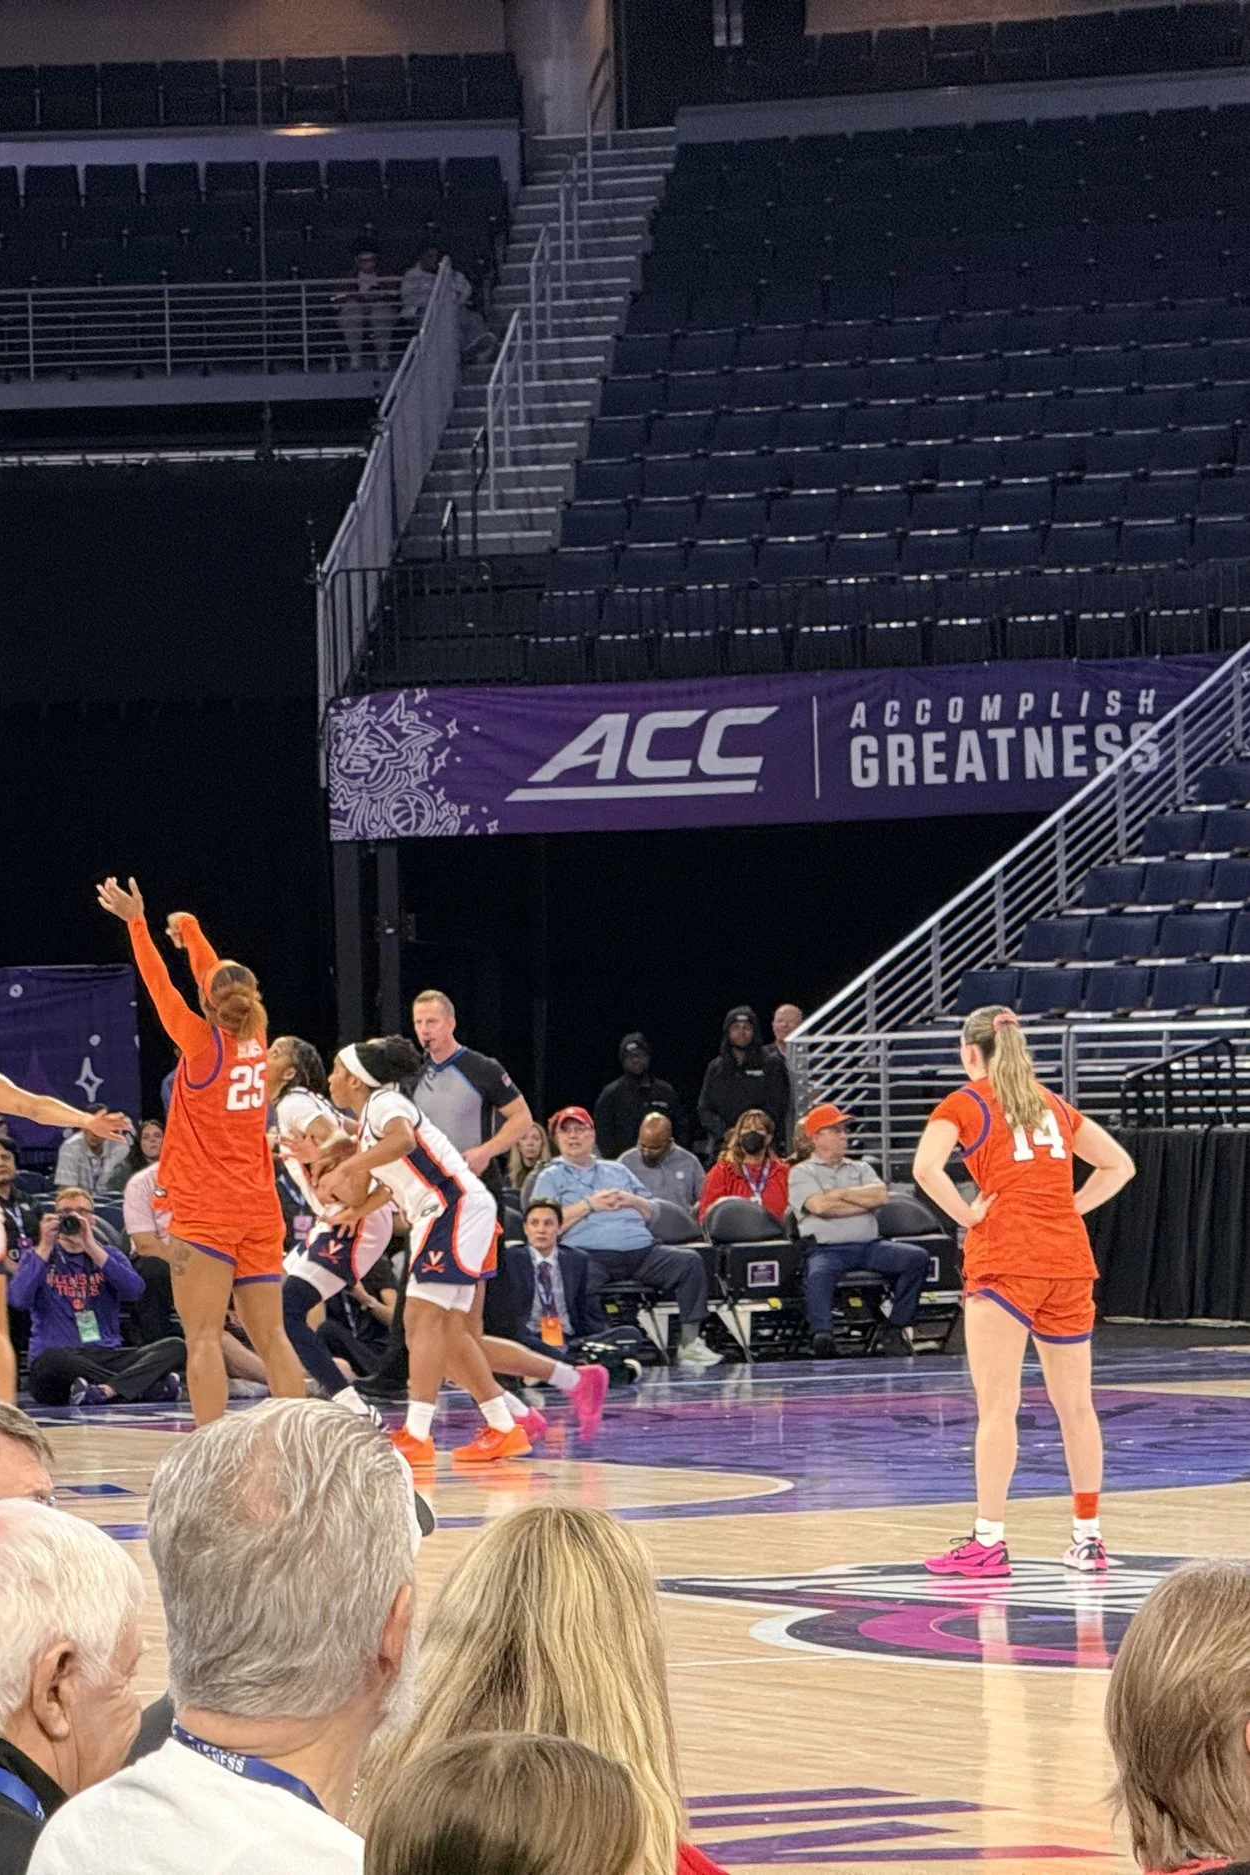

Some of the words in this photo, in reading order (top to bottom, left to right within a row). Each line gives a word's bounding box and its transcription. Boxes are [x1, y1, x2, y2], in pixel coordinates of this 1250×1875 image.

[850, 688, 1156, 729] ACCOMPLISH
[527, 706, 780, 782] ACC
[850, 721, 1160, 789] GREATNESS
[226, 1061, 267, 1111] 25
[1004, 1108, 1067, 1162] 14
[46, 1271, 105, 1286] CLEMSN
